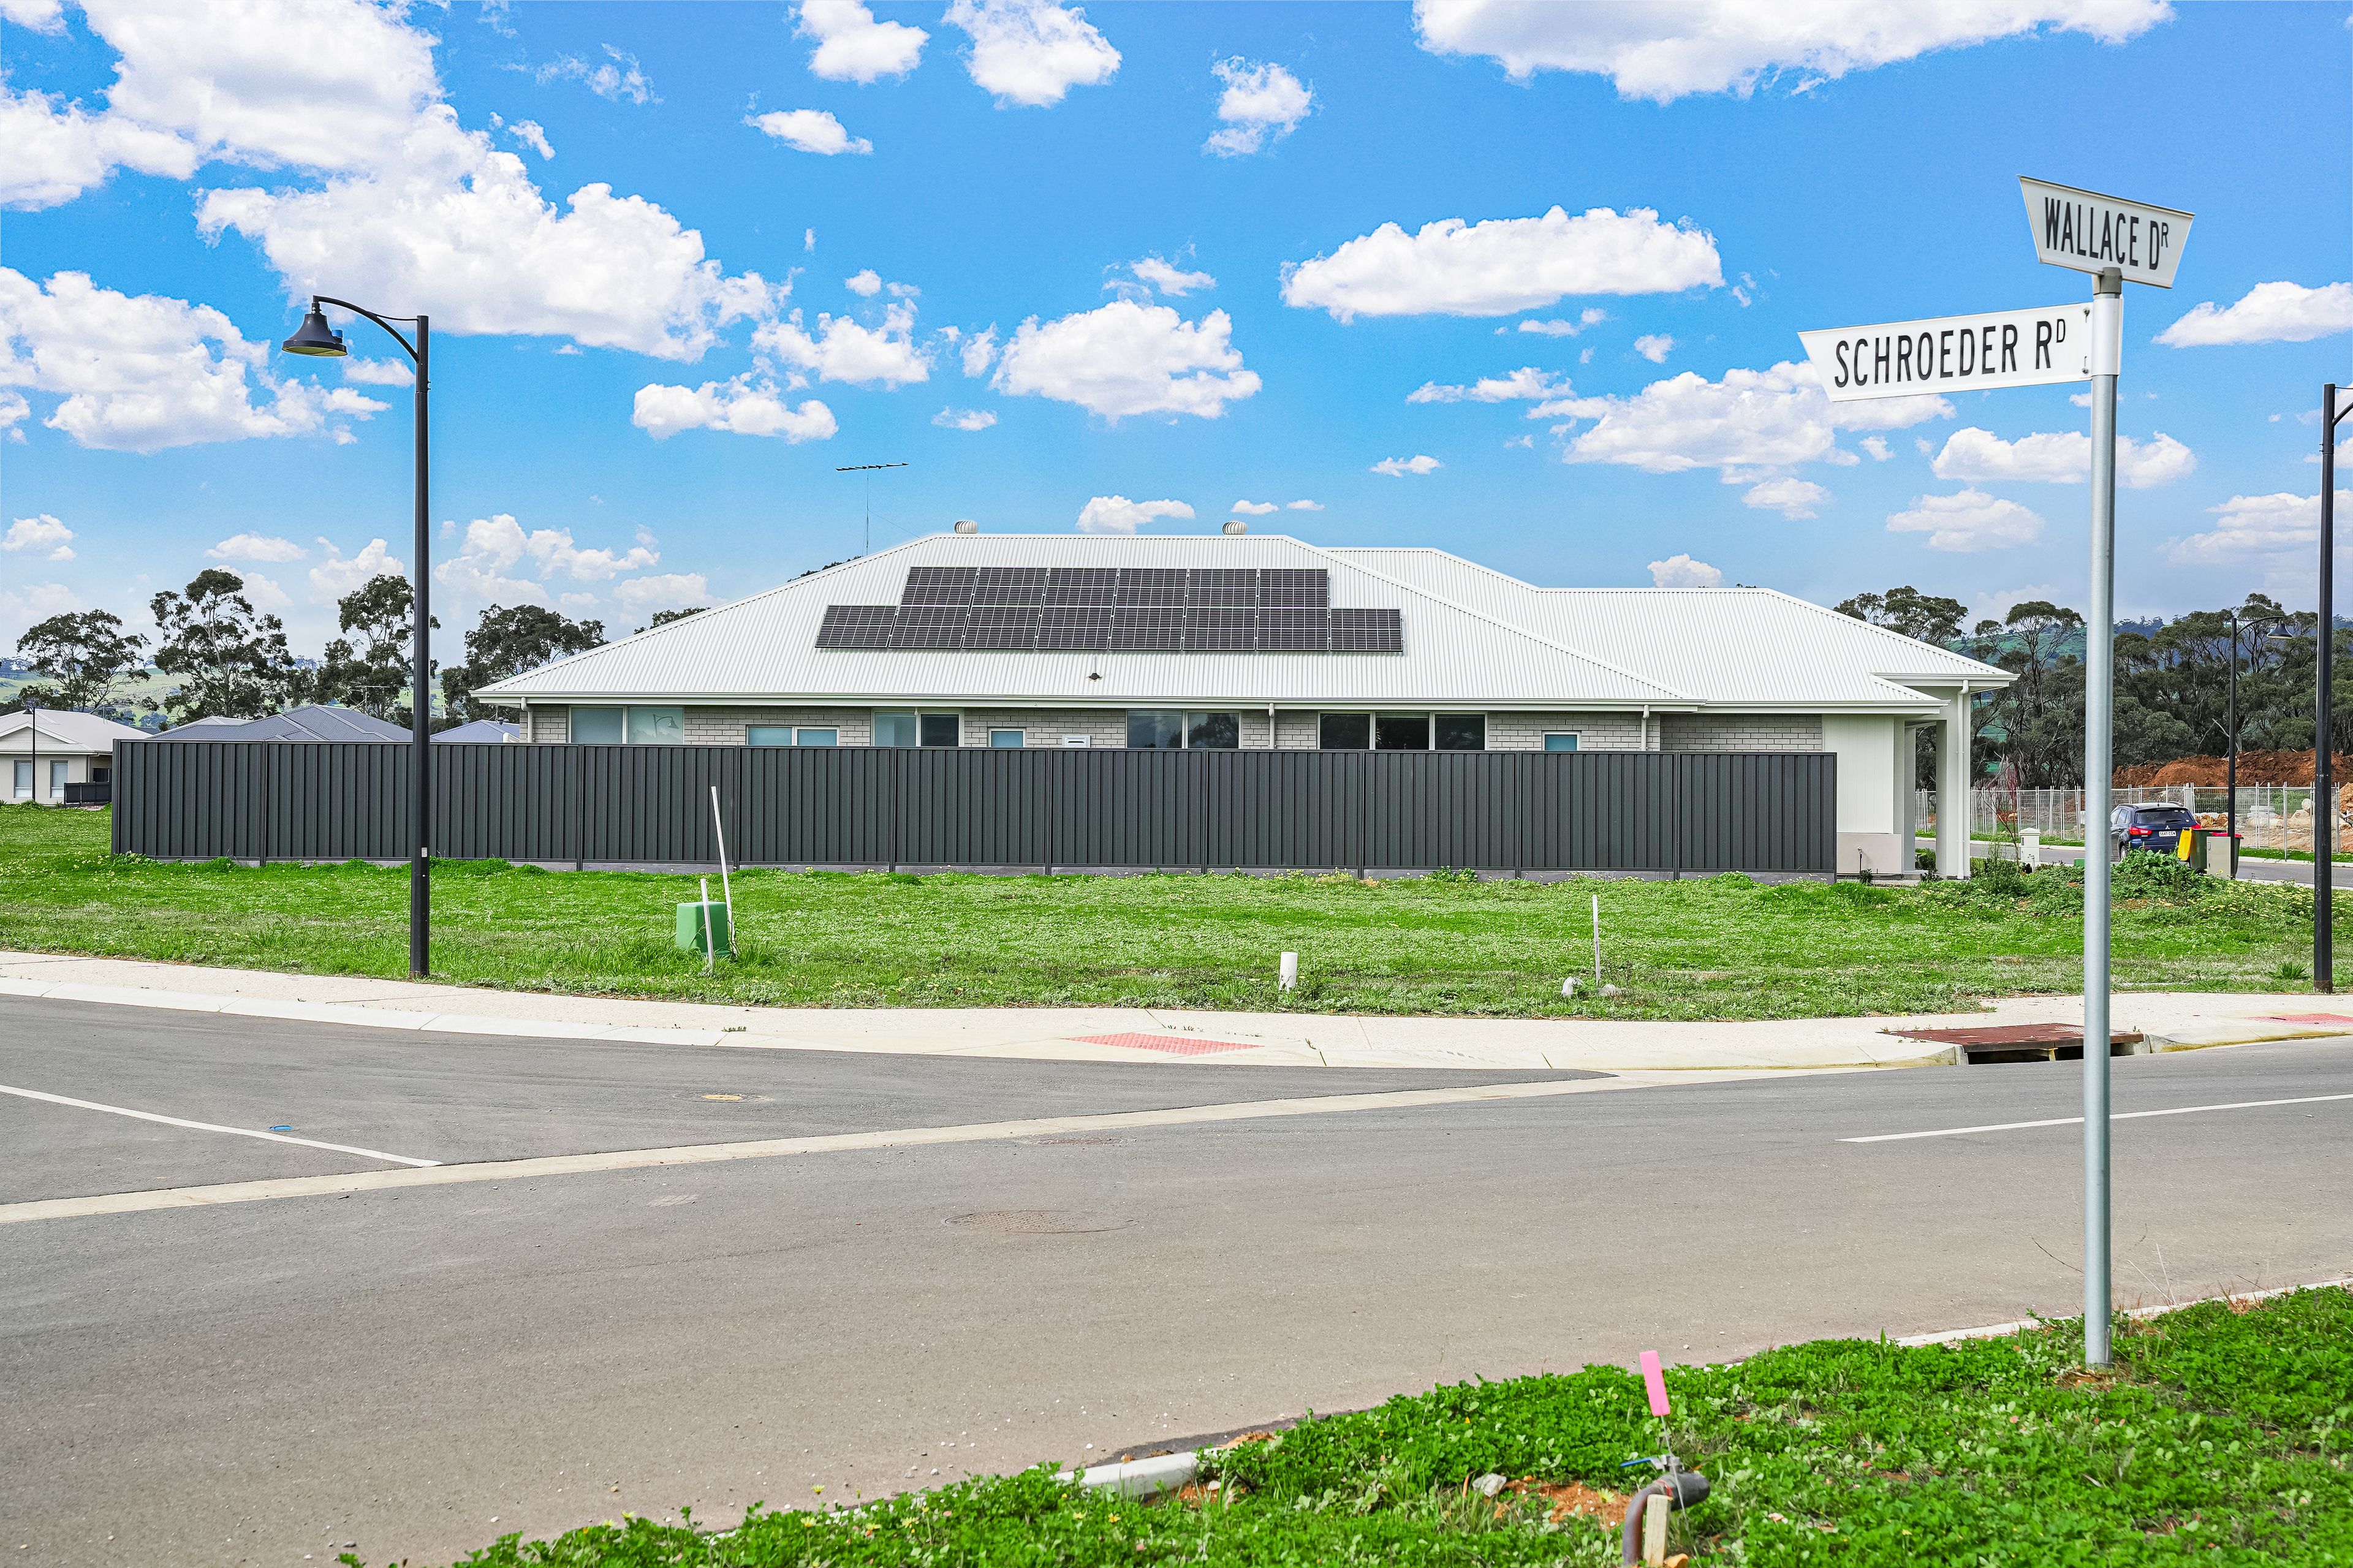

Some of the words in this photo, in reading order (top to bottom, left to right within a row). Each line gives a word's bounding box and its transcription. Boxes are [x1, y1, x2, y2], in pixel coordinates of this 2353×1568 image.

[2045, 197, 2139, 267] WALLACE
[2149, 220, 2169, 270] DR
[1834, 324, 2017, 388] SCHROEDER
[2036, 319, 2066, 369] RD
